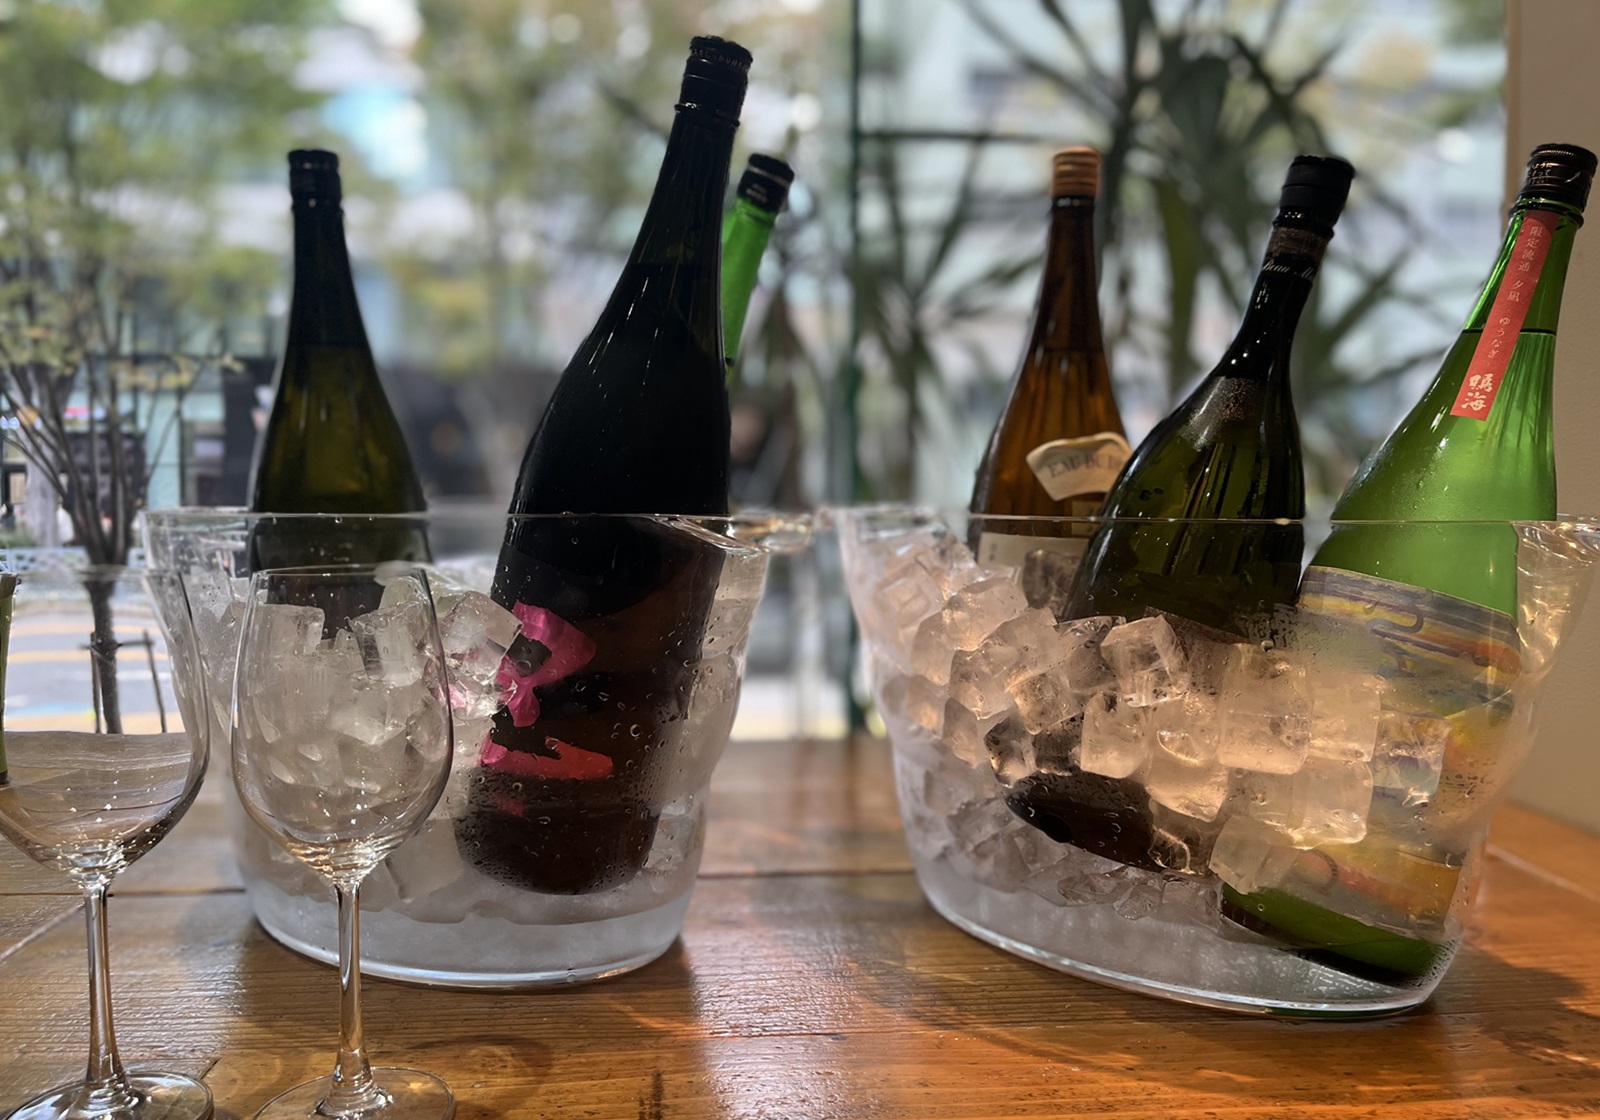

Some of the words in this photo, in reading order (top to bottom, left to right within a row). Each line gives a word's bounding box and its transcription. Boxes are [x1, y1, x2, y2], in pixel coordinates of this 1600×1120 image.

[1517, 226, 1543, 272] 限定流通
[1262, 258, 1291, 274] Beau
[1506, 280, 1524, 303] 夕凪
[1488, 316, 1511, 359] ゆうなぎ
